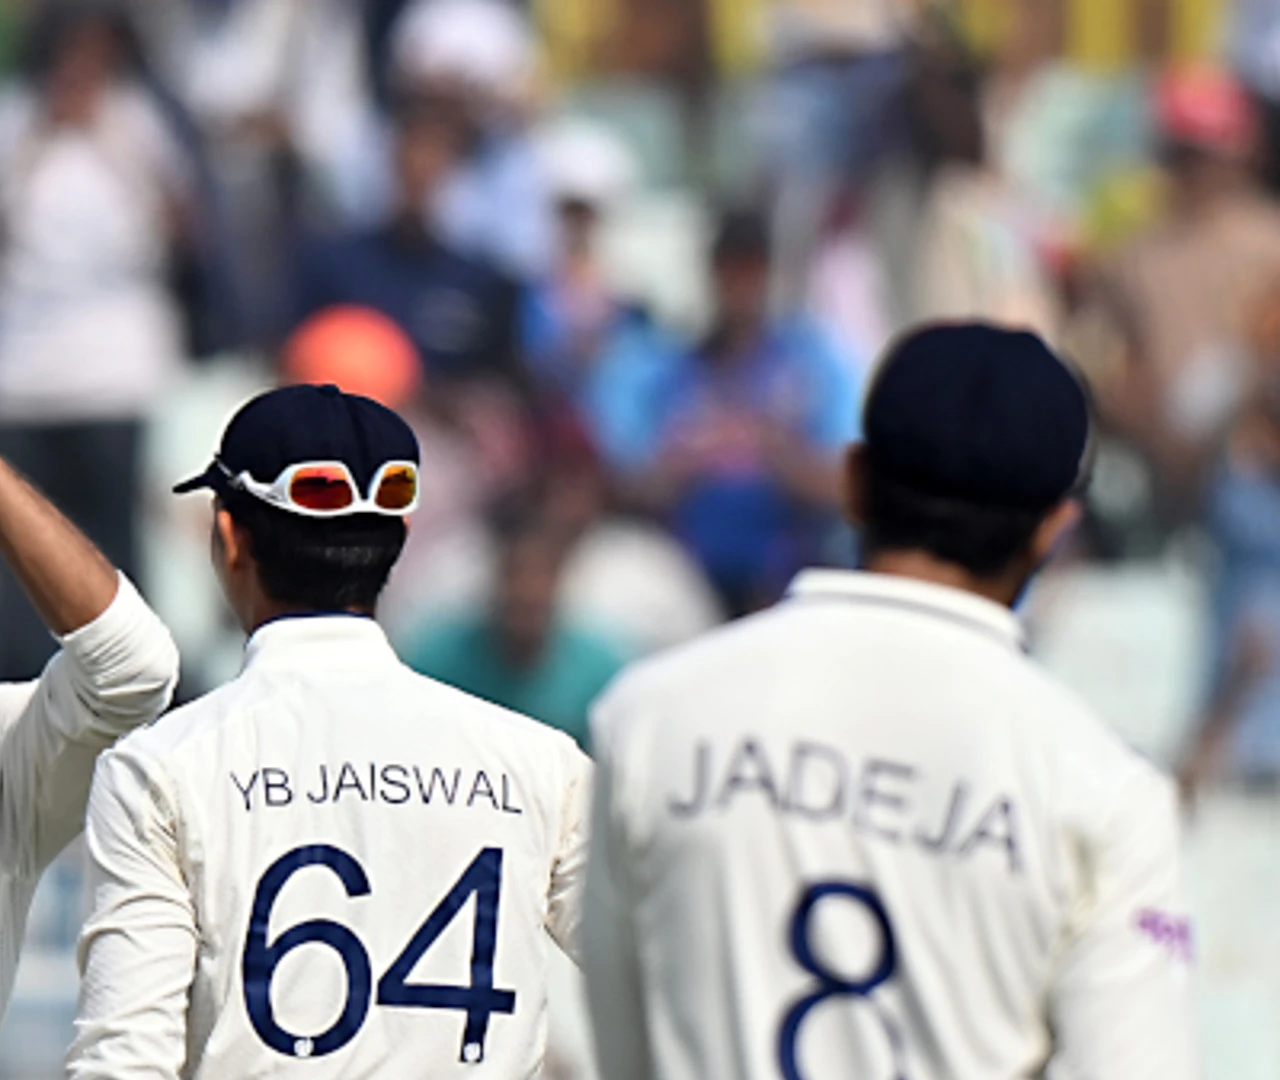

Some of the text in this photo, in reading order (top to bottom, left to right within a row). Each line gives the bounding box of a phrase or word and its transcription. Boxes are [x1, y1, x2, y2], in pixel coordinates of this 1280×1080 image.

[230, 762, 523, 815] YB JAISWAL
[666, 733, 1025, 874] JADEJA
[240, 842, 518, 1065] 64
